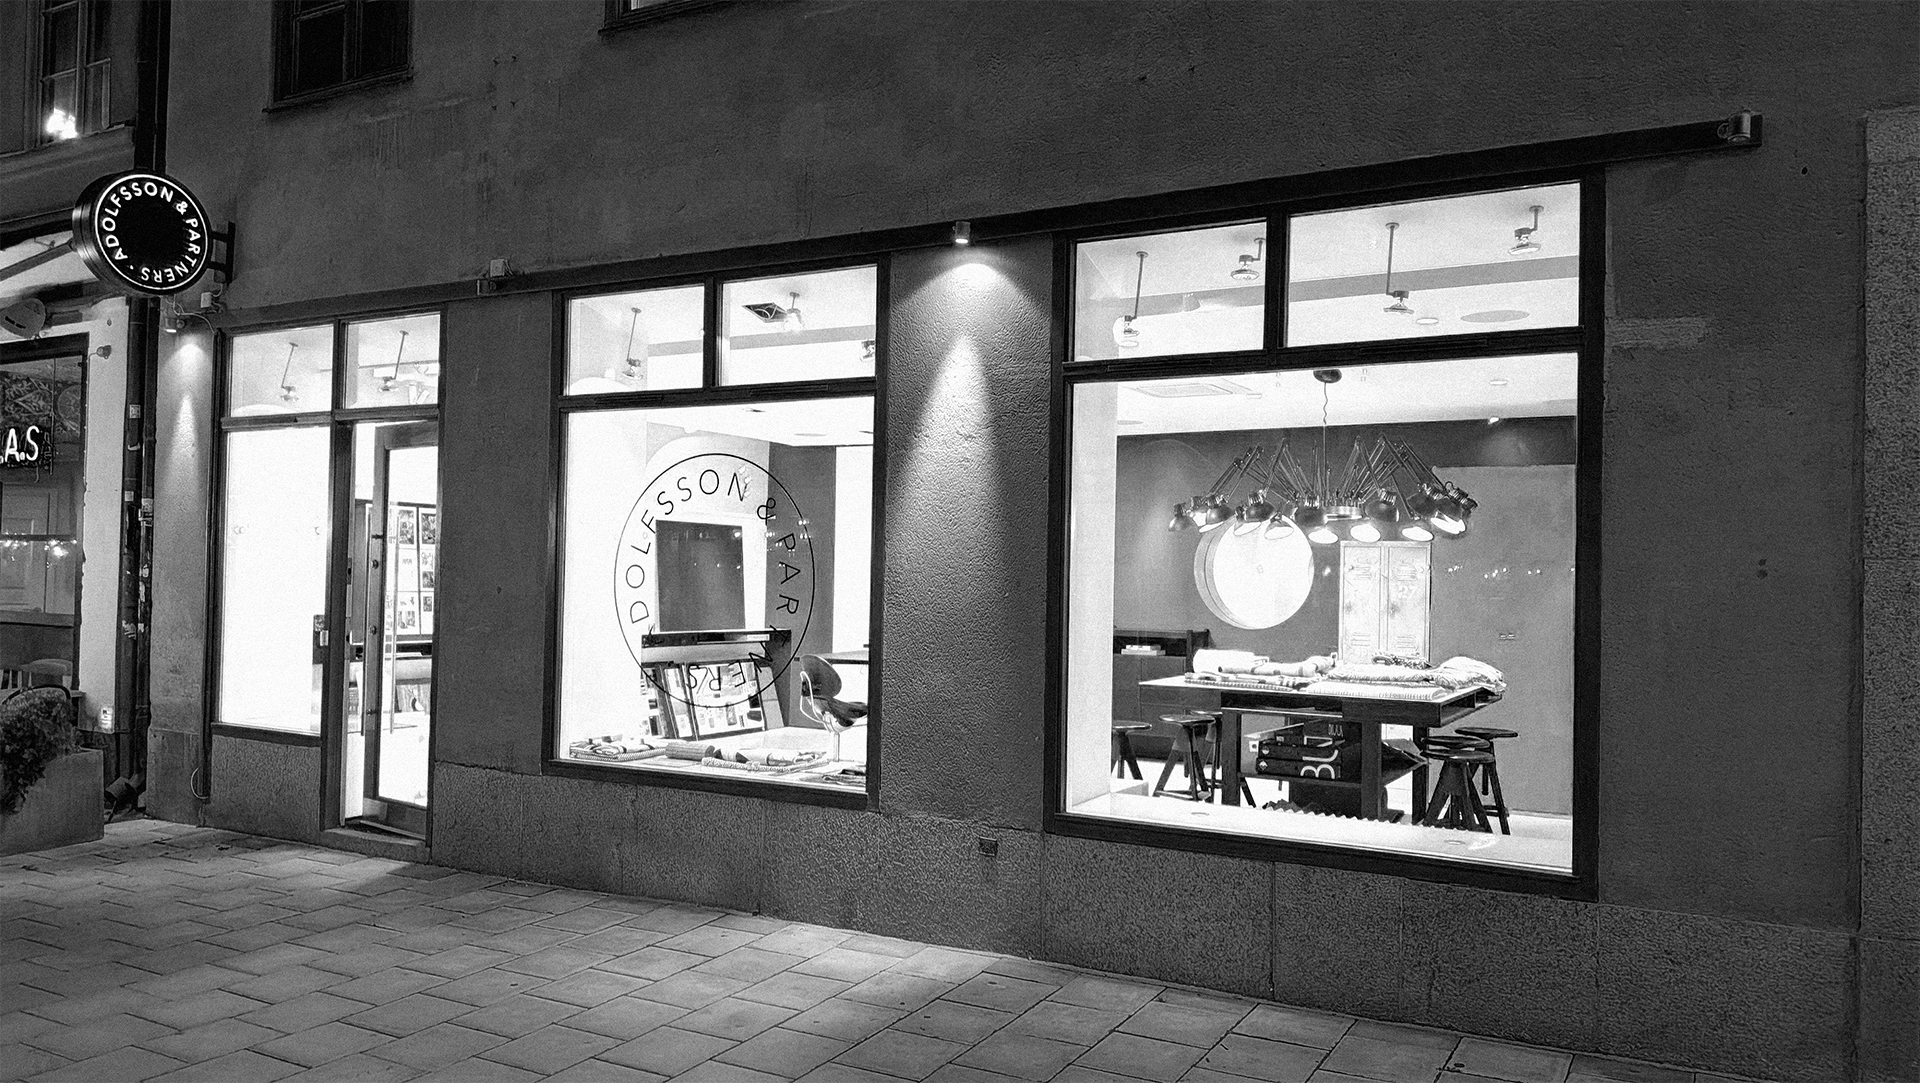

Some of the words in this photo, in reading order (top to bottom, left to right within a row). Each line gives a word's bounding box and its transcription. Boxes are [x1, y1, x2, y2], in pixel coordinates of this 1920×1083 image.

[102, 182, 174, 261] ADOLFSSON
[176, 201, 188, 215] &
[141, 218, 201, 283] PARTNERS
[757, 497, 777, 526] &
